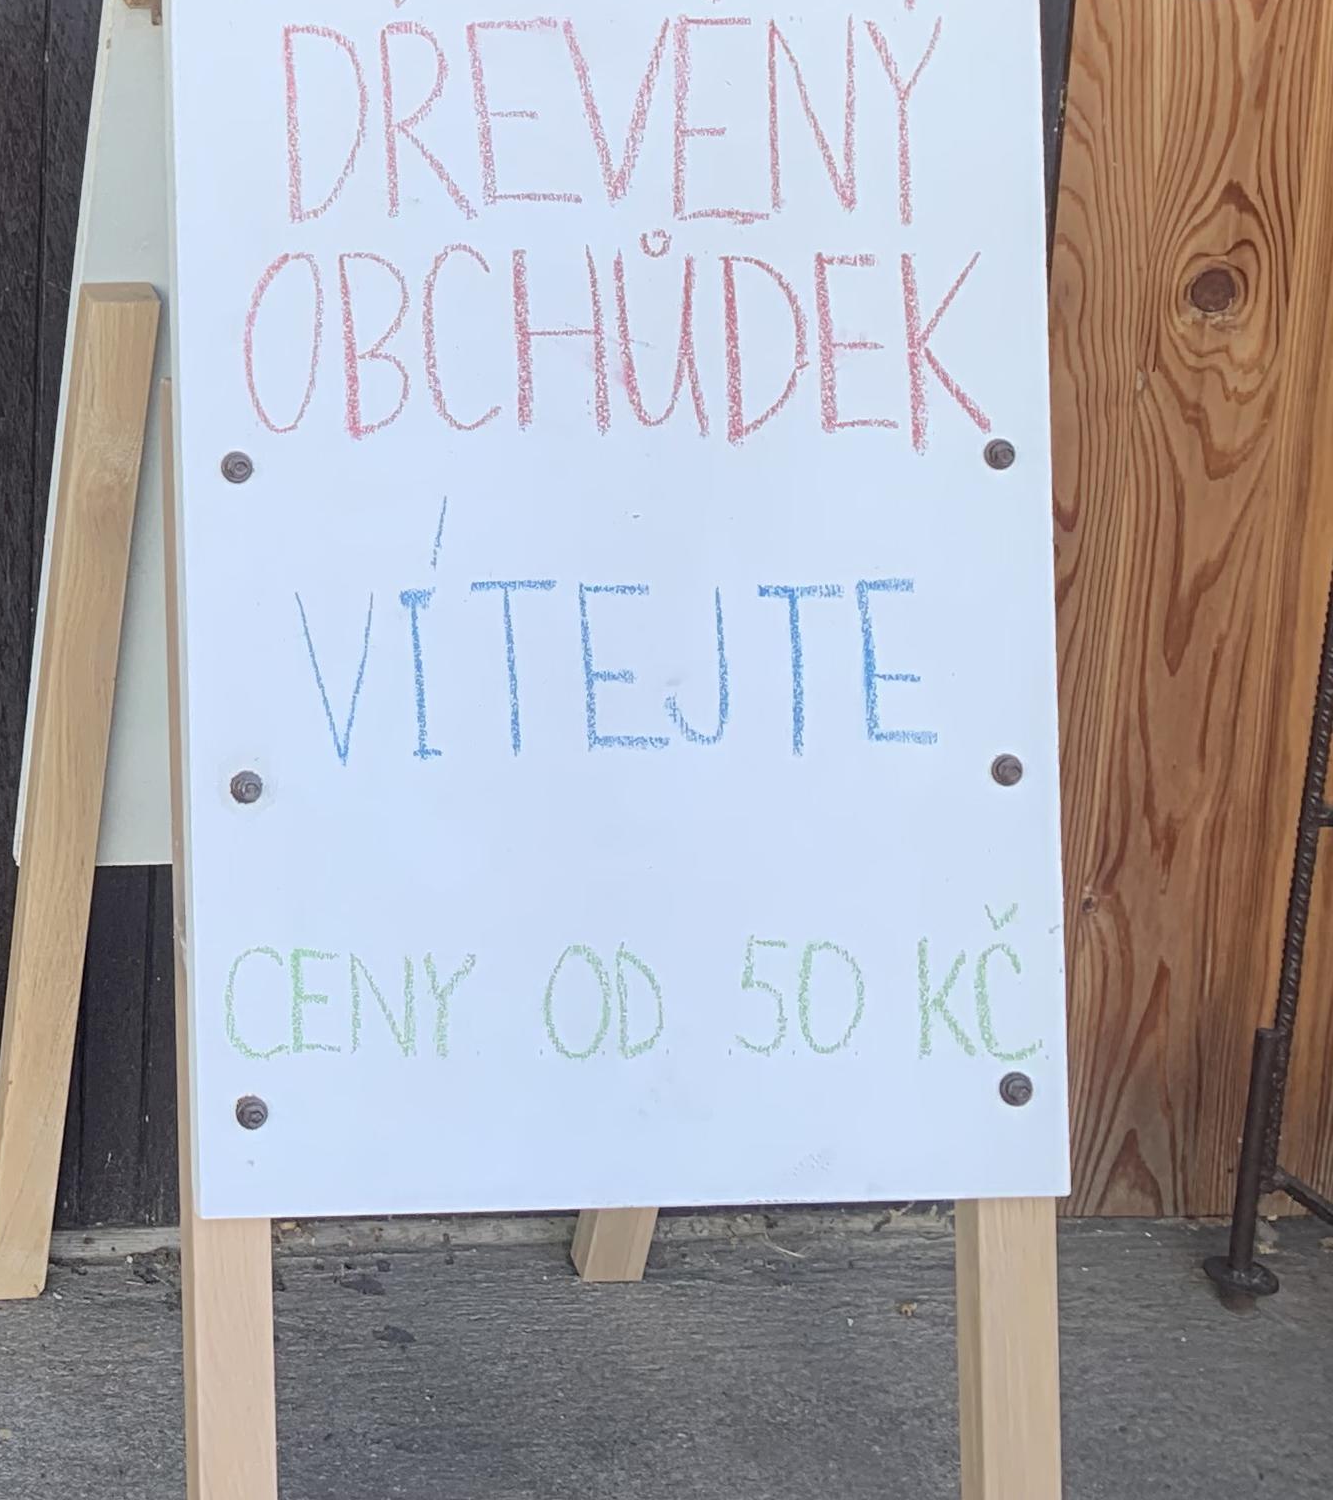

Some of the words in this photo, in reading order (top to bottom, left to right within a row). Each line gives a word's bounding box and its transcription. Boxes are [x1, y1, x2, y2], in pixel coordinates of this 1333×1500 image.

[243, 228, 992, 456] OBCHŮDEK
[294, 495, 939, 768] VÍTEJTE
[224, 944, 478, 1060] CENY
[541, 940, 666, 1060] OD
[733, 934, 867, 1056] 50
[916, 903, 1045, 1062] KČ
